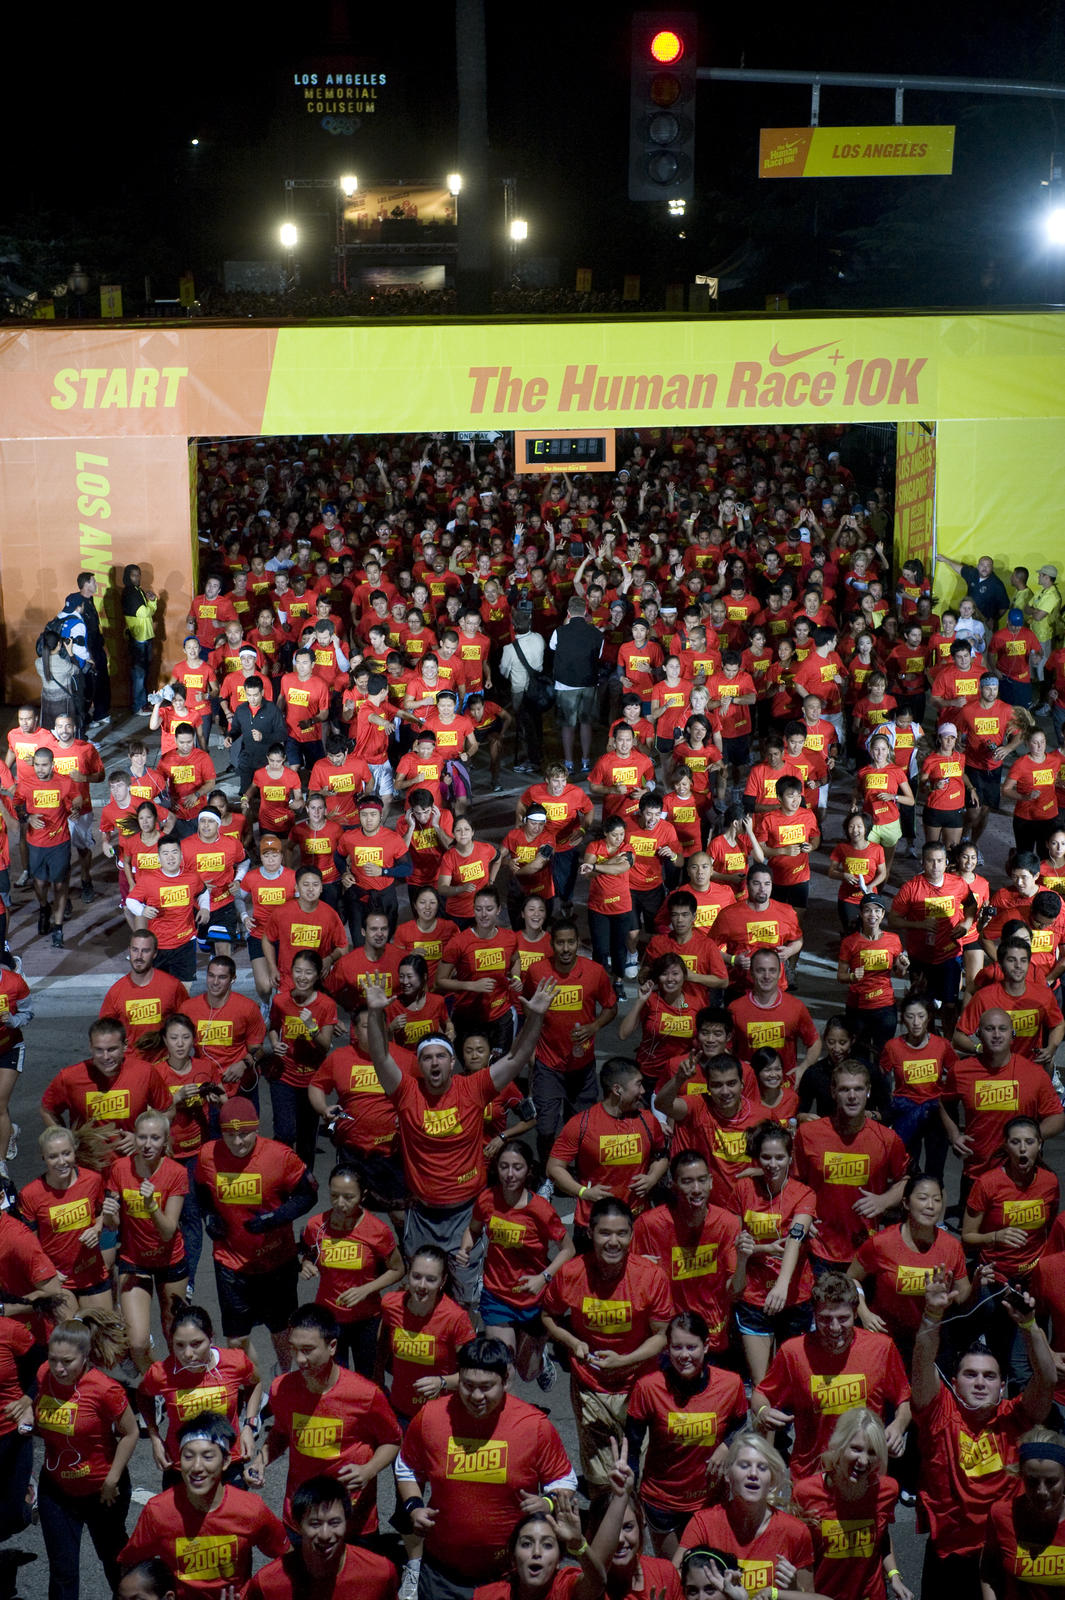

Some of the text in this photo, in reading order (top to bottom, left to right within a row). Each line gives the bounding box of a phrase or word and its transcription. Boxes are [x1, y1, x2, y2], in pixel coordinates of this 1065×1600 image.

[294, 74, 387, 85] LOS ANGELES
[304, 88, 378, 99] MEMORIAL
[307, 102, 375, 113] COLISEUM
[832, 143, 928, 158] LOS ANGELES
[51, 367, 188, 410] START
[468, 357, 928, 413] The Human Race 10K
[460, 432, 473, 440] ONE
[76, 451, 112, 519] LOS
[333, 778, 352, 790] 2009
[616, 771, 635, 781] 2009
[37, 793, 57, 803] 2009
[782, 828, 803, 839] 2009
[309, 841, 329, 850] 2009
[633, 842, 654, 851] 2009
[140, 858, 159, 867] 2009
[200, 857, 222, 867] 2009
[358, 851, 380, 862] 2009
[464, 865, 481, 878] 2009
[848, 862, 867, 871] 2009
[163, 890, 186, 903] 2009
[261, 891, 283, 901] 2009
[294, 929, 318, 942] 2009
[752, 925, 776, 939] 2009
[1032, 936, 1050, 948] 009
[480, 951, 503, 967] 2009
[864, 954, 887, 967] 2009
[130, 1003, 158, 1021] 2009
[287, 1023, 308, 1035] 200
[664, 1019, 690, 1031] 2009
[1012, 1014, 1035, 1030] 009
[201, 1026, 229, 1042] 2009
[752, 1027, 780, 1043] 2009
[355, 1072, 379, 1088] 200
[908, 1064, 935, 1080] 2009
[980, 1086, 1014, 1106] 2009
[91, 1096, 125, 1116] 2009
[425, 1113, 457, 1135] 2009
[605, 1141, 638, 1161] 2009
[829, 1161, 864, 1179] 2009
[222, 1181, 256, 1200] 2009
[56, 1204, 88, 1228] 2009
[1010, 1206, 1041, 1225] 2009
[325, 1246, 358, 1263] 2009
[902, 1275, 928, 1291] 200
[588, 1308, 627, 1328] 2009
[397, 1341, 430, 1357] 2009
[818, 1380, 861, 1408] 2009
[296, 1426, 336, 1448] 2009
[673, 1419, 712, 1440] 2009
[453, 1449, 501, 1474] 2009
[185, 1544, 231, 1574] 2009
[1021, 1553, 1065, 1578] 2009
[741, 1568, 767, 1590] 09
